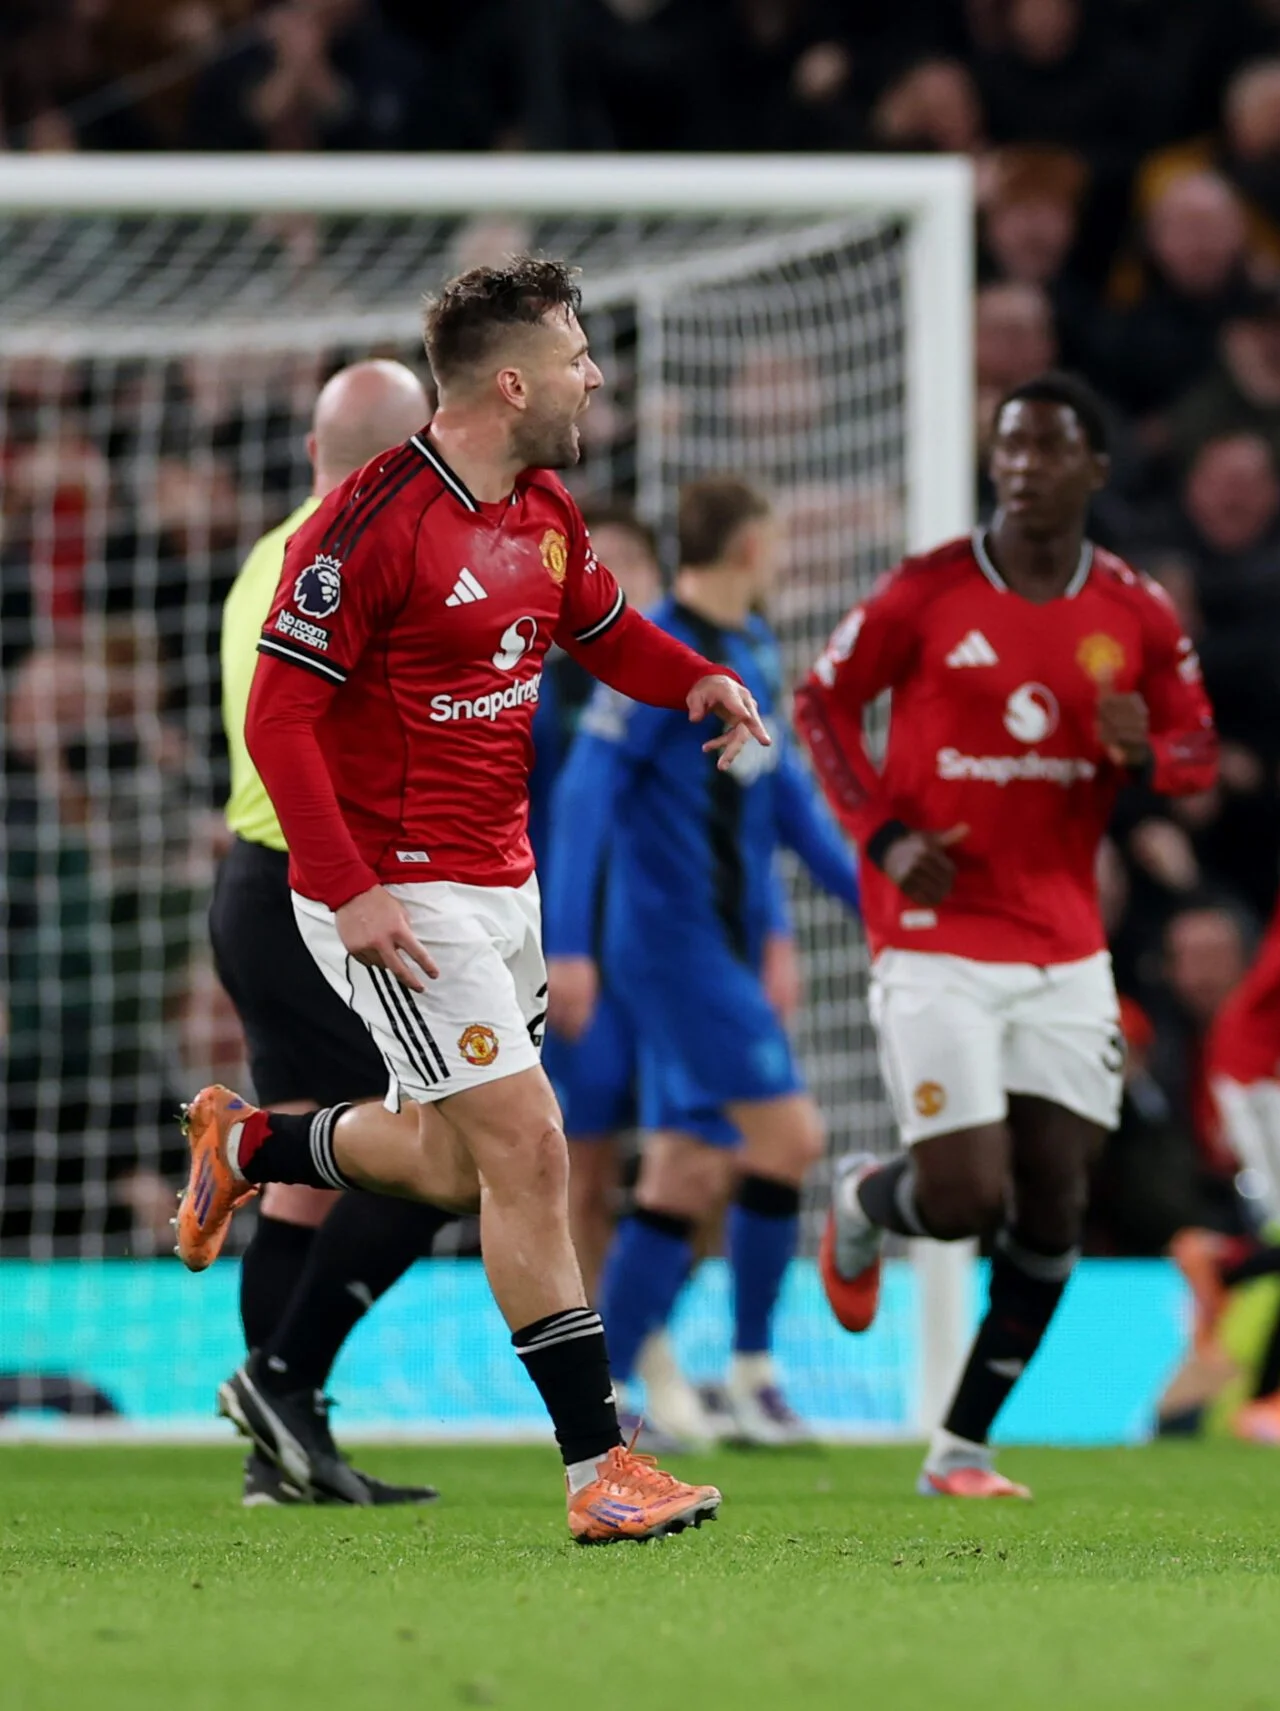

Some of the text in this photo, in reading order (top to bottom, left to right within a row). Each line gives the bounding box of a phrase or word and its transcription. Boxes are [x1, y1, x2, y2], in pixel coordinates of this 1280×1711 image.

[279, 609, 328, 640] No room
[290, 628, 329, 651] racism
[429, 672, 542, 722] Snapdrag
